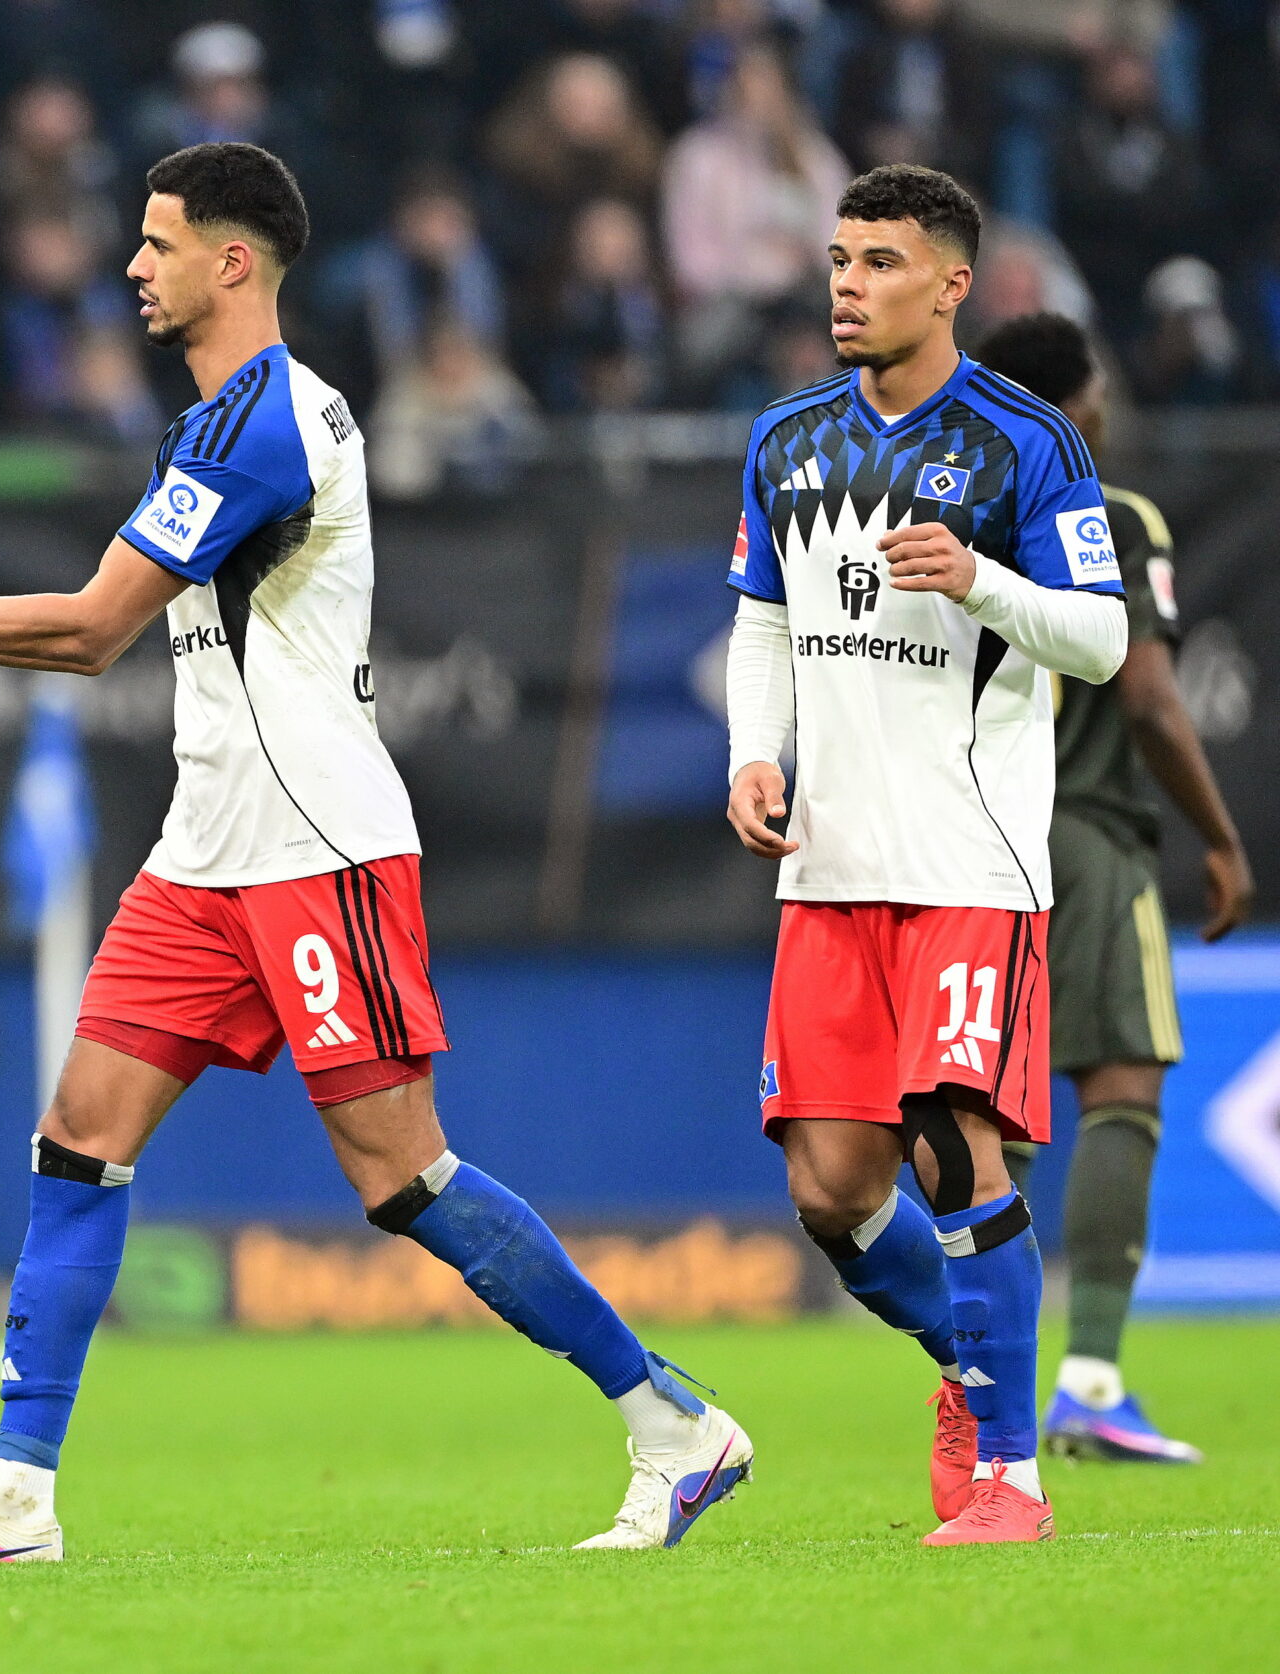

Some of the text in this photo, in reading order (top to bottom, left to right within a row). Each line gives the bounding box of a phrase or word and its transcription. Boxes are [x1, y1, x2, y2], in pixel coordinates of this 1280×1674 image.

[150, 508, 191, 540] PLAN
[1078, 549, 1117, 566] PLAN
[292, 933, 340, 1014] 9
[937, 962, 1000, 1042] 11
